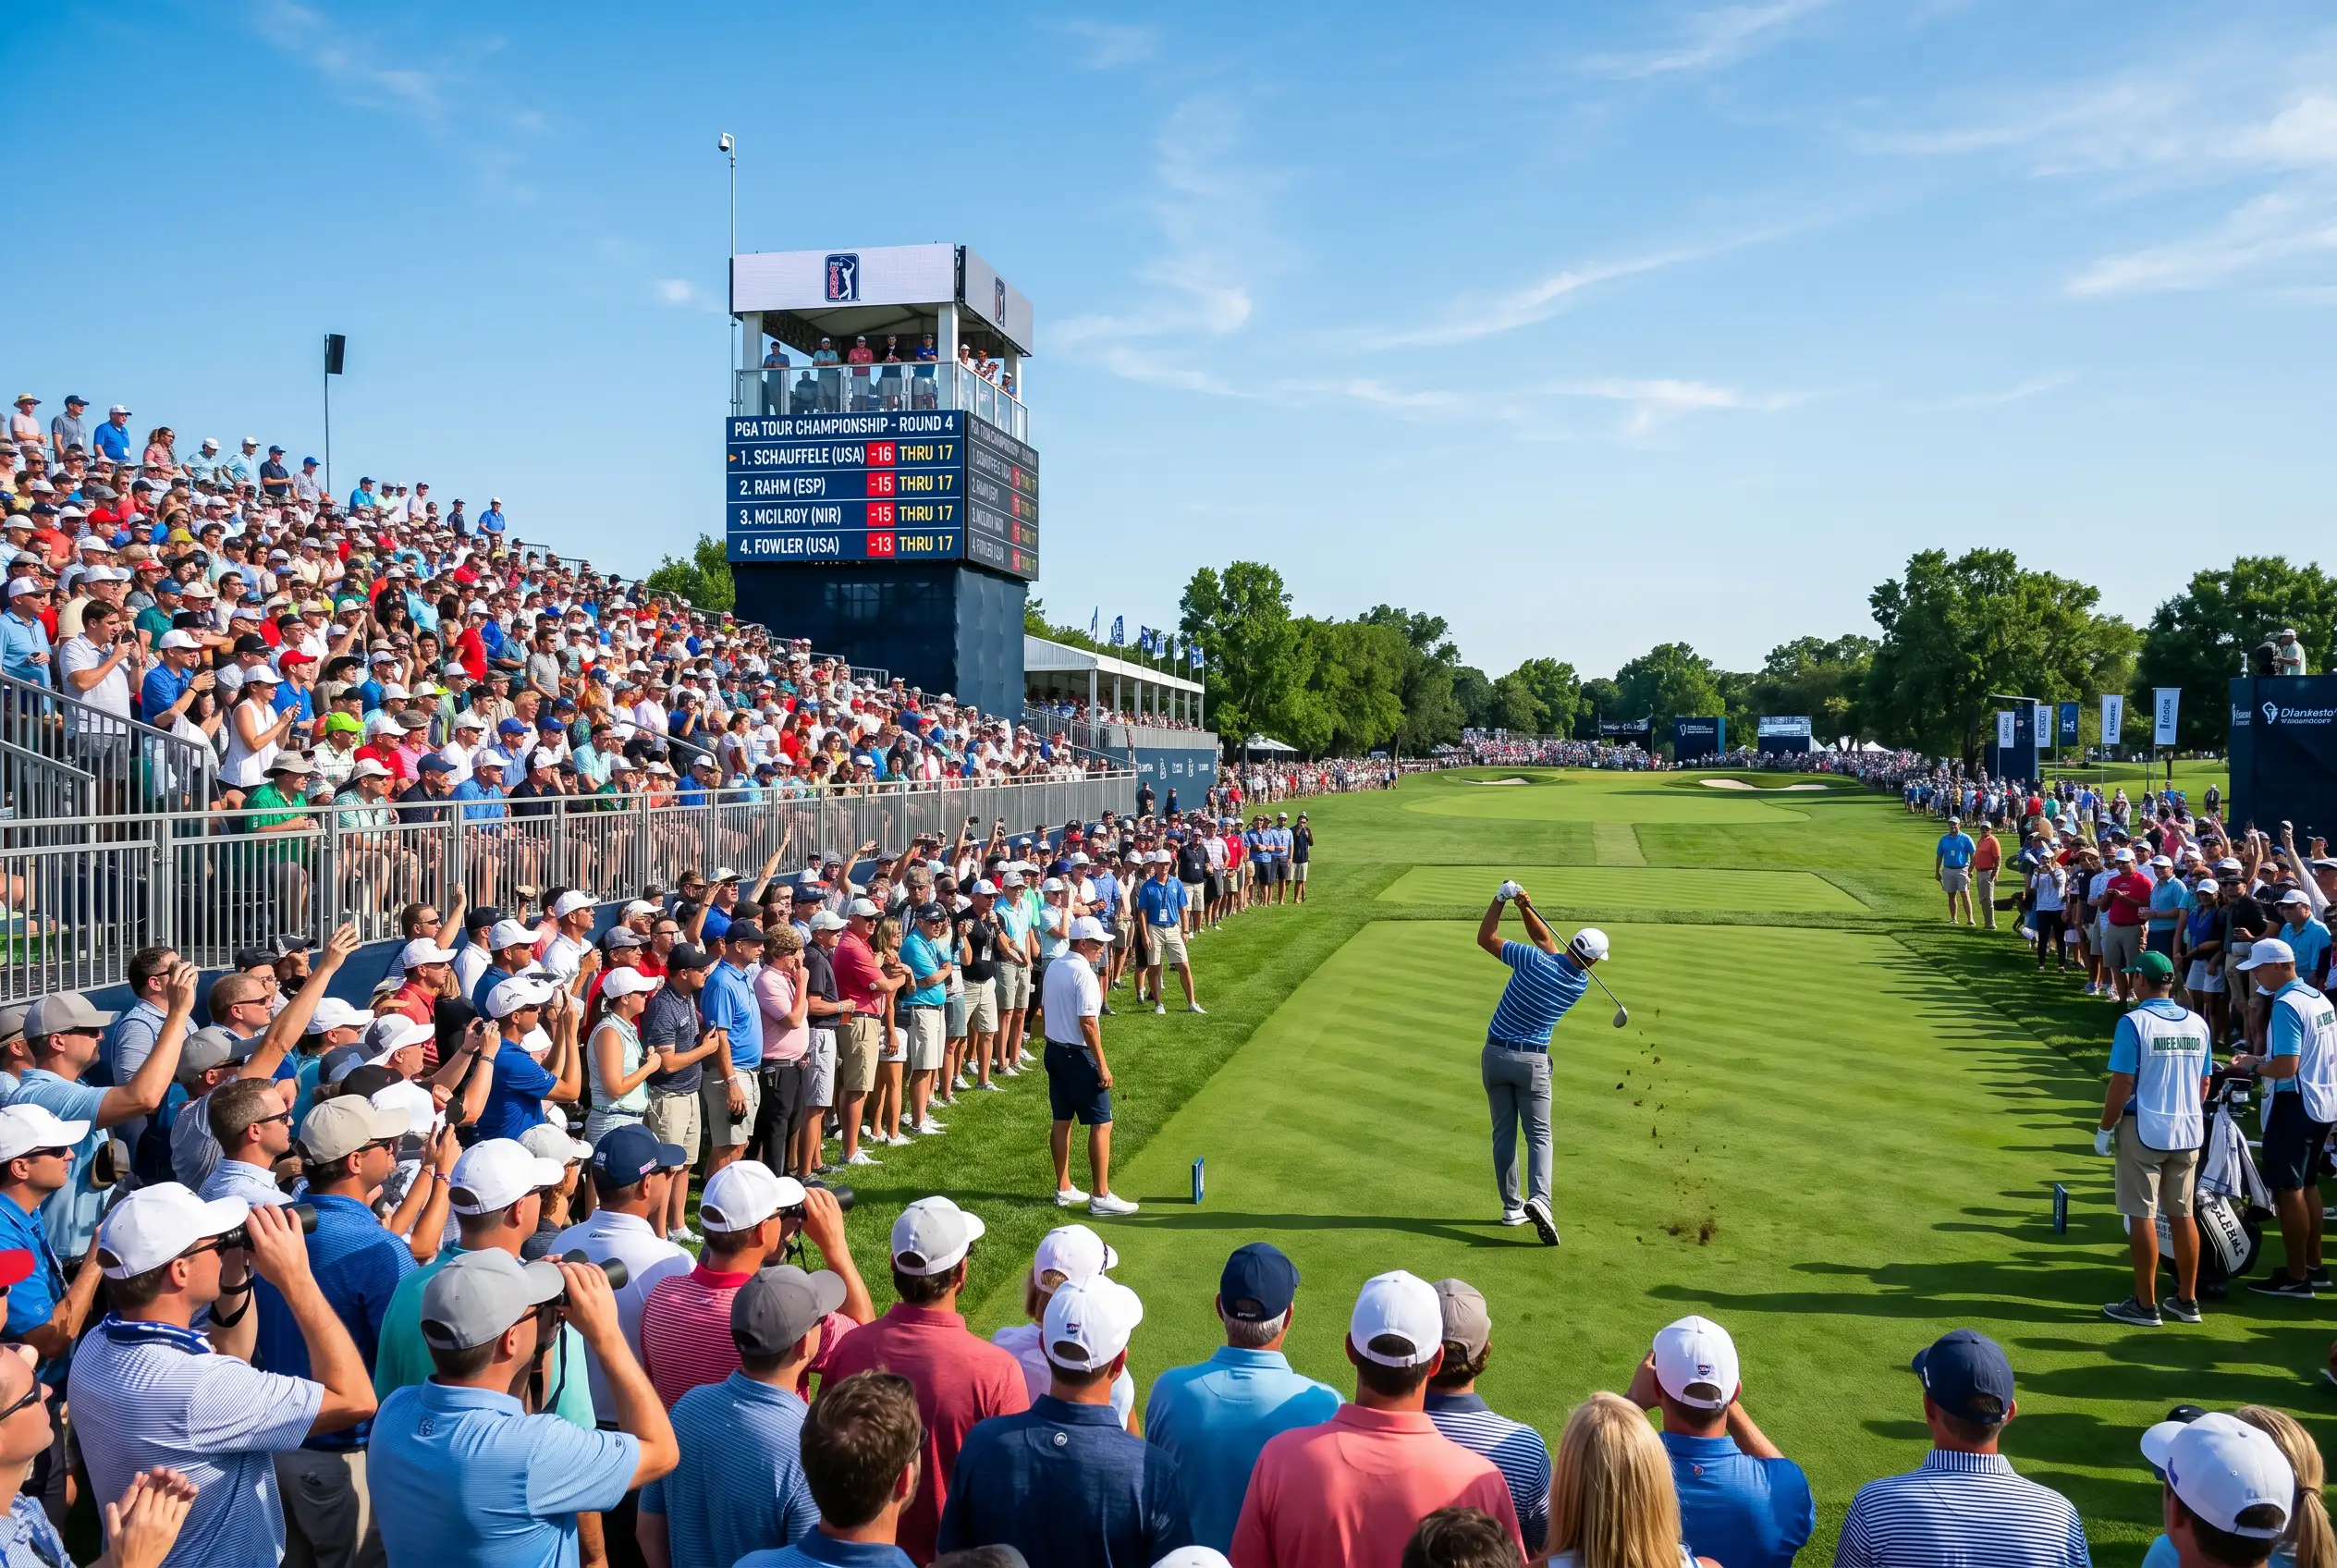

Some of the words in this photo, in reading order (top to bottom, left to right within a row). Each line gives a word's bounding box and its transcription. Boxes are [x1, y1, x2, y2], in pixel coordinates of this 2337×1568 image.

[735, 422, 758, 436] PGA
[762, 420, 792, 435] TOUR
[796, 417, 888, 435] CHAMPIONSHIP
[899, 415, 941, 432] ROUND
[945, 415, 954, 431] 4
[740, 449, 752, 465] 1.
[753, 447, 829, 465] SCHAUFFELE
[832, 446, 864, 466] (USA)
[871, 447, 892, 461] -16
[899, 445, 934, 461] THRU
[938, 445, 953, 460] 17
[740, 480, 752, 496] 2.
[754, 478, 790, 495] RAHM
[793, 477, 826, 496] (ESP)
[871, 476, 892, 492] -15
[899, 475, 934, 491] THRU
[937, 474, 953, 490] 17
[740, 509, 752, 524] 3.
[754, 508, 808, 524] MCILROY
[811, 506, 841, 526] (NIR)
[871, 507, 892, 521] -15
[899, 506, 934, 521] THRU
[937, 505, 953, 521] 17
[740, 540, 752, 555] 4.
[754, 538, 802, 554] FOWLER
[806, 536, 839, 555] (USA)
[870, 536, 892, 552] -13
[899, 536, 934, 551] THRU
[937, 535, 953, 551] 17
